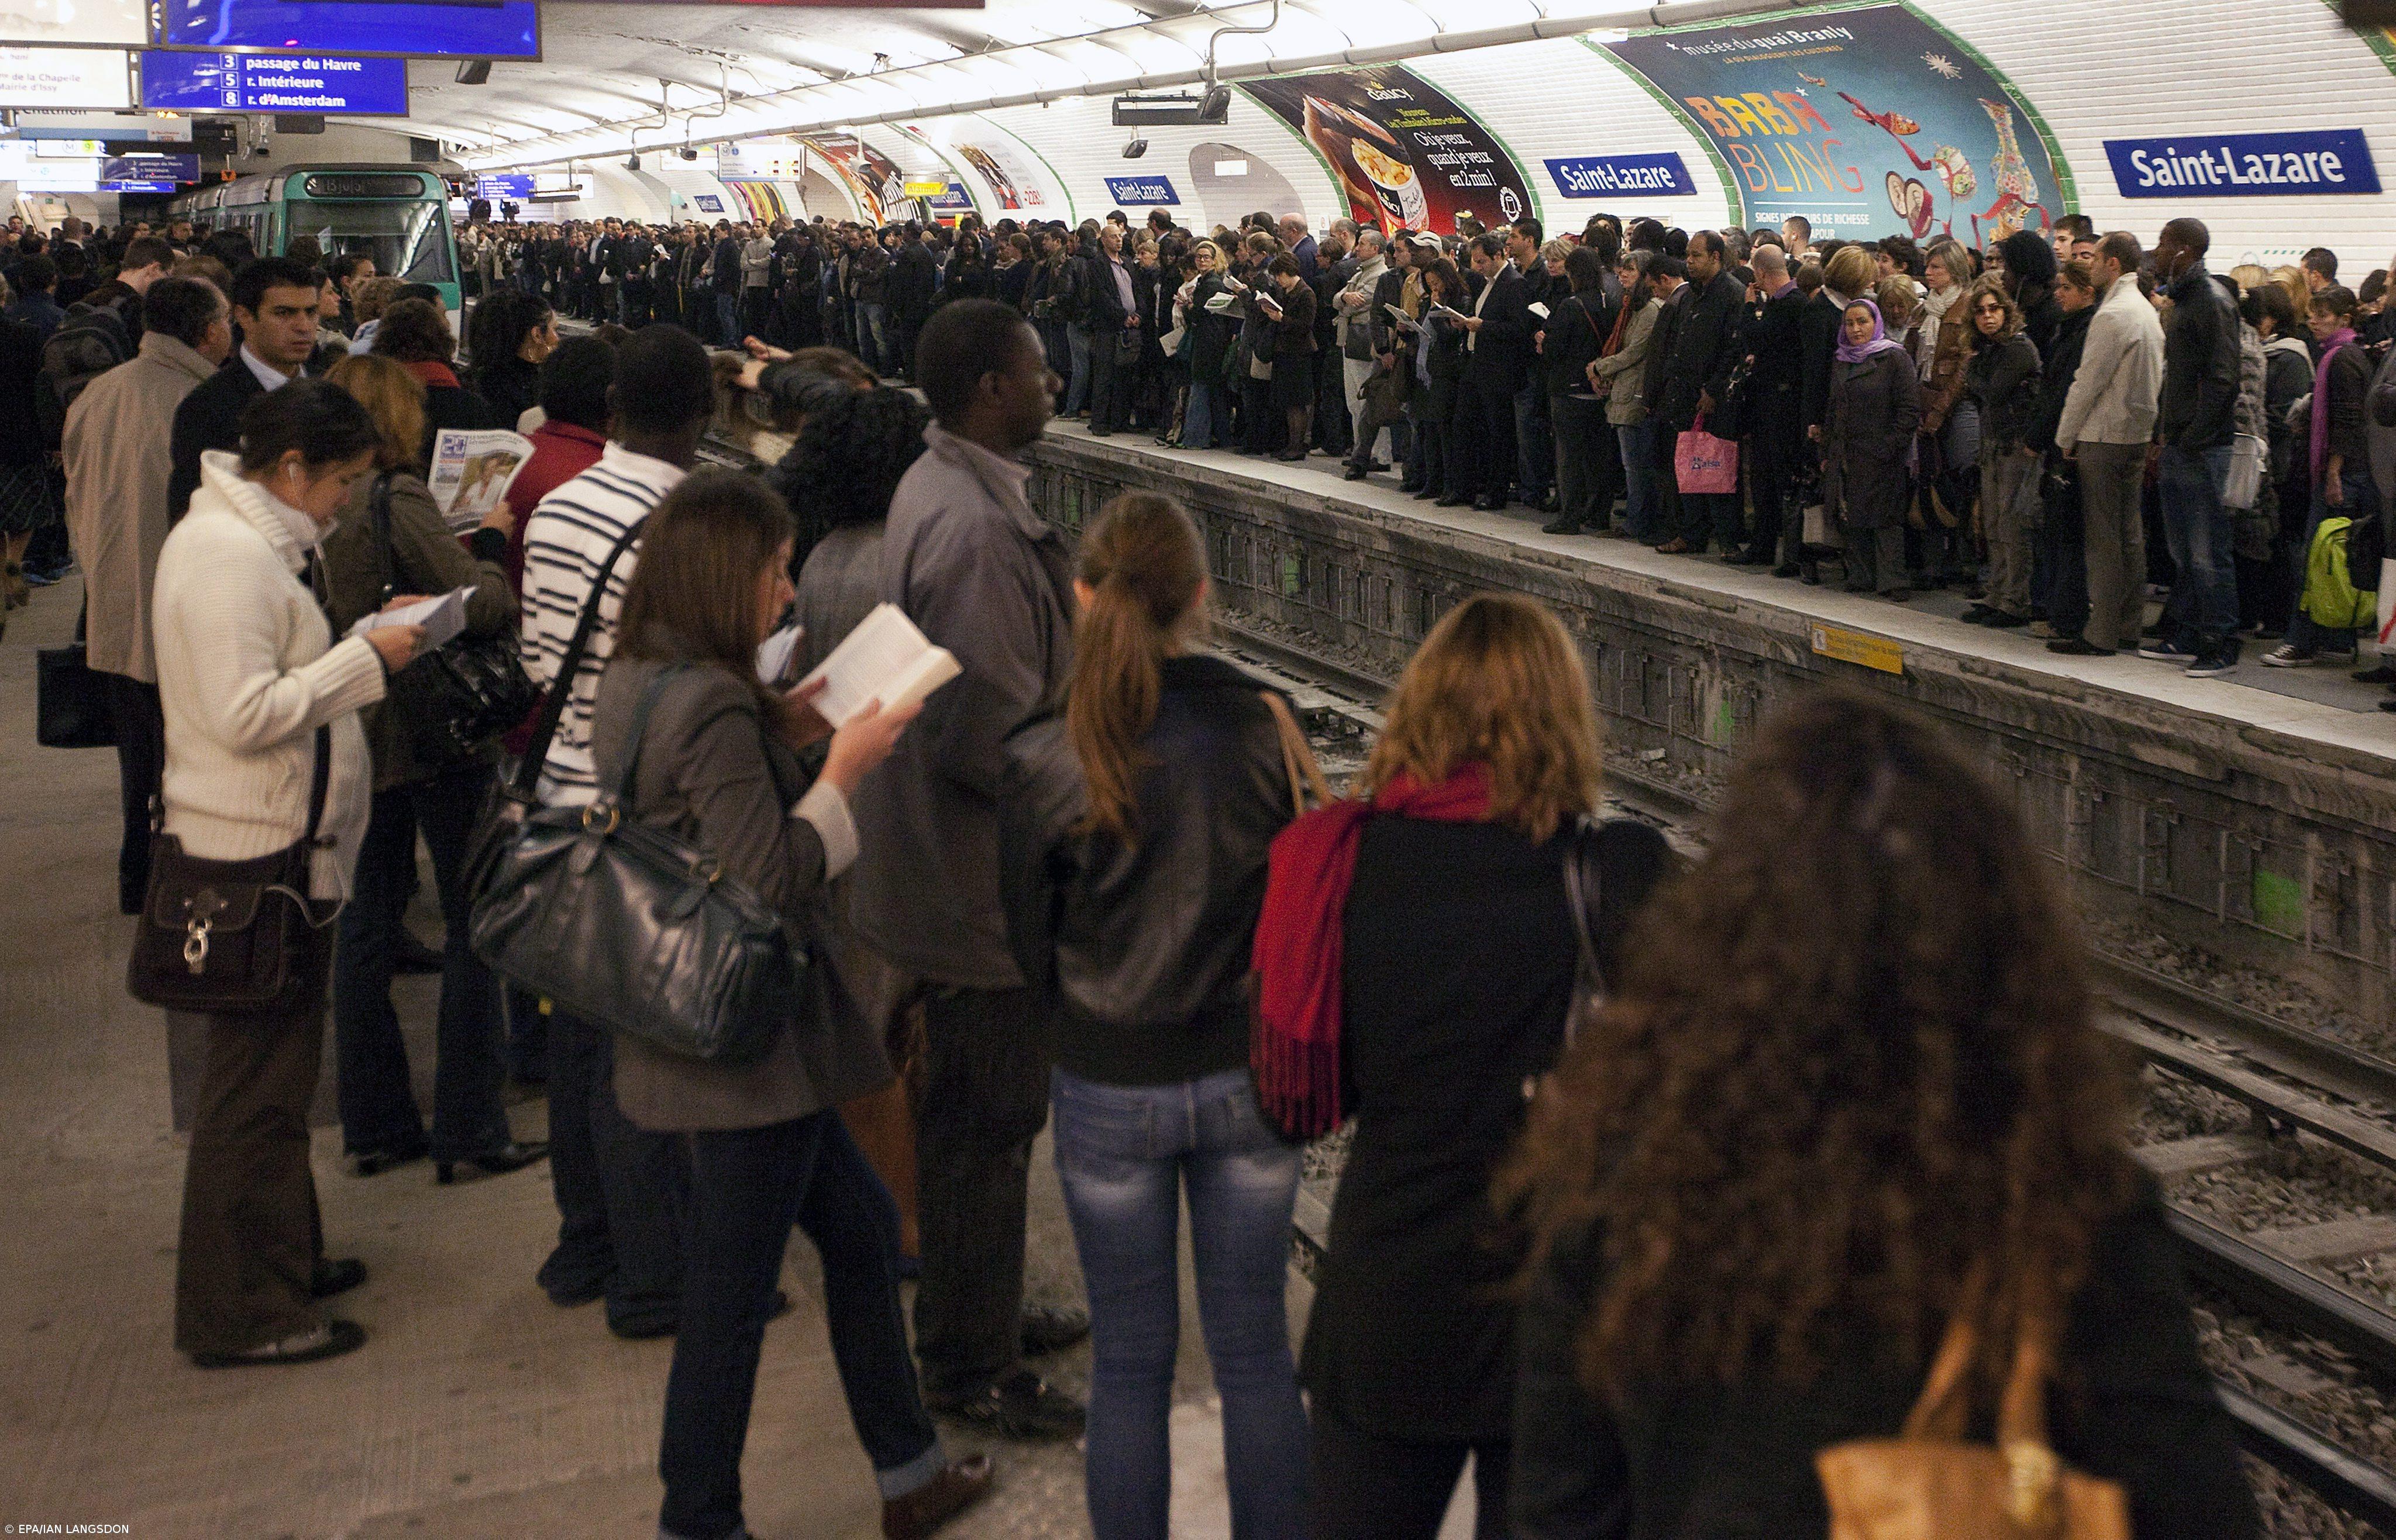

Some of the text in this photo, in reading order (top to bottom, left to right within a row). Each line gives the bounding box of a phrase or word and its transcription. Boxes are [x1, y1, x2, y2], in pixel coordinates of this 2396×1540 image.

[1682, 26, 1853, 56] musée du quai Branly
[224, 55, 362, 71] 3 passage du Havre
[225, 74, 324, 88] 5 r. Intérieure
[226, 92, 346, 106] 8 r. d'Amsterdam
[1684, 91, 1832, 137] BABA
[1413, 131, 1473, 150] Où je veux,
[1427, 149, 1493, 170] quand je veux
[1729, 139, 1864, 192] BLING
[2130, 146, 2346, 187] Saint-Lazare
[1450, 174, 1463, 187] en
[1469, 170, 1489, 185] min
[1560, 164, 1676, 191] Saint-Lazare
[908, 184, 936, 193] Alarme
[1112, 181, 1169, 201] Saint-Lazare
[1755, 212, 1779, 223] SIGNES
[1822, 213, 1833, 224] DE
[1834, 213, 1870, 225] RICHESSE
